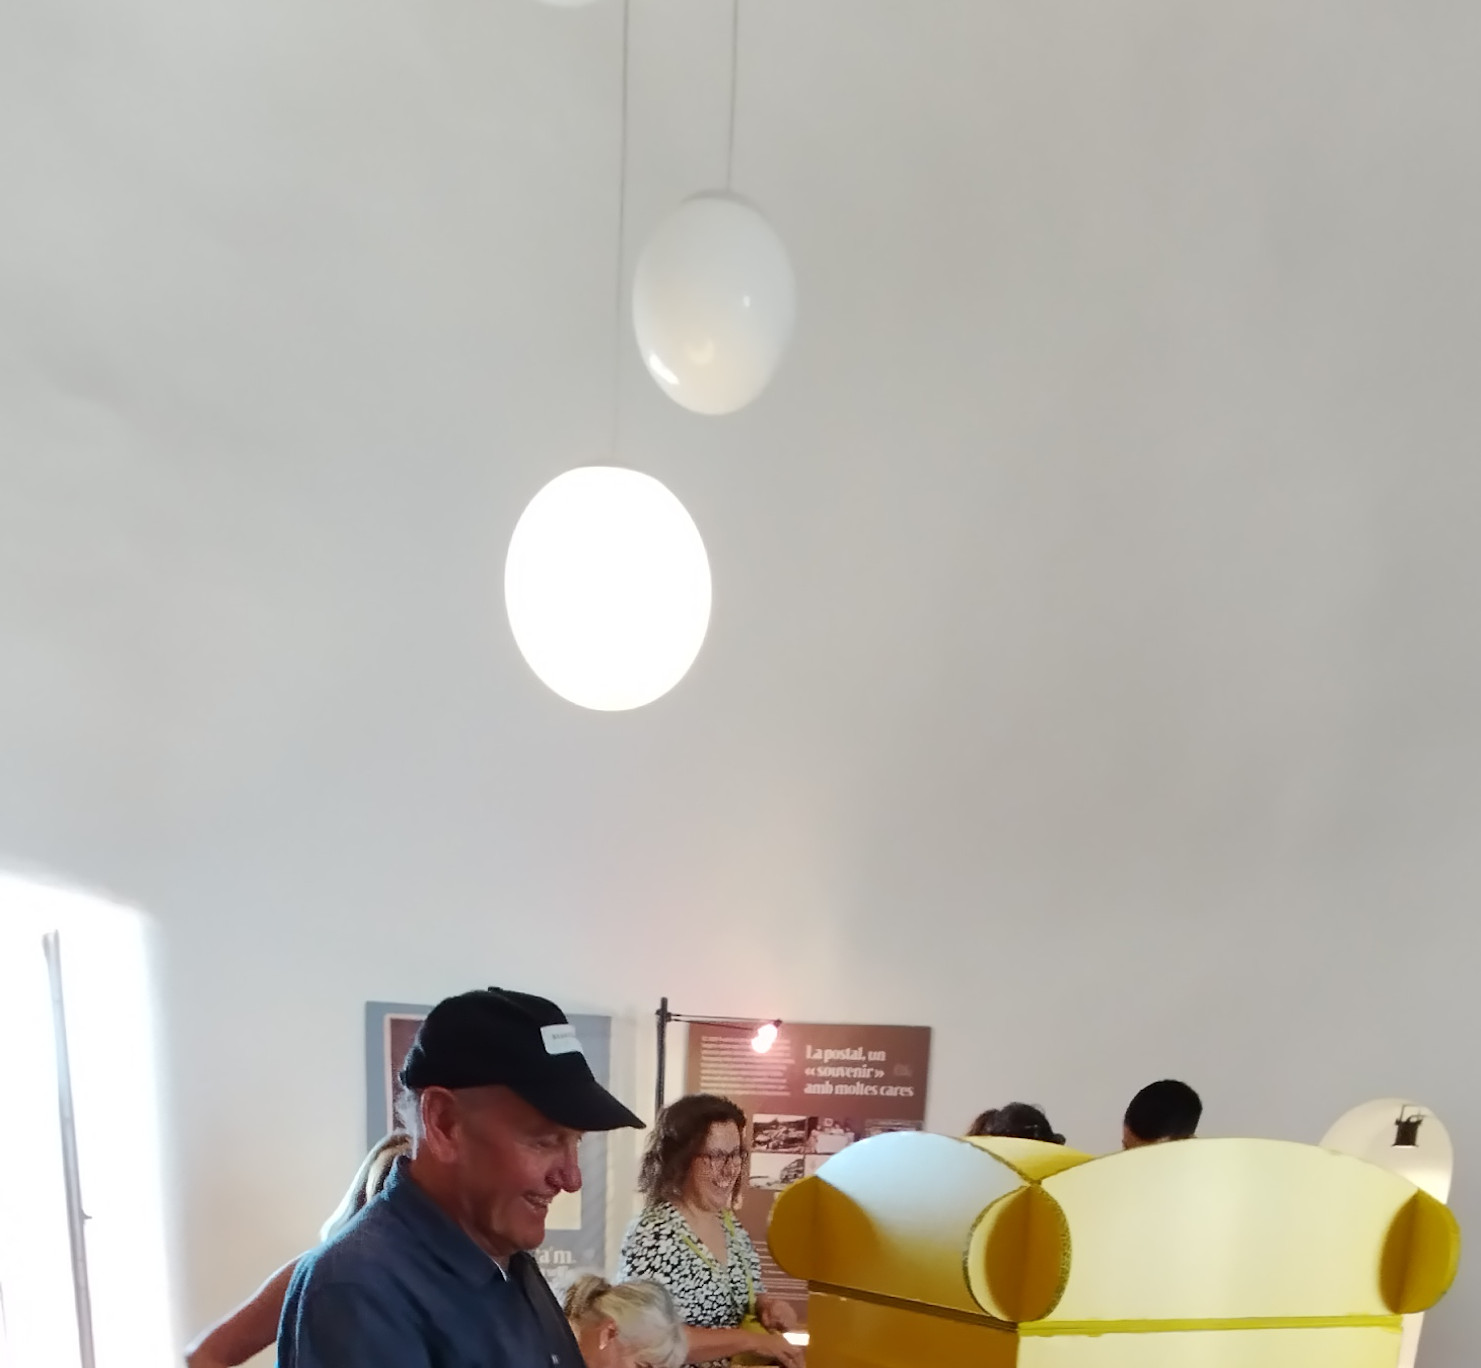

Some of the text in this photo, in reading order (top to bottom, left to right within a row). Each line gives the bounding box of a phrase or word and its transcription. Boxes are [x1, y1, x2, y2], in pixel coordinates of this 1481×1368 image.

[806, 1045, 886, 1063] La postal, un
[804, 1080, 914, 1097] amb moltes cares
